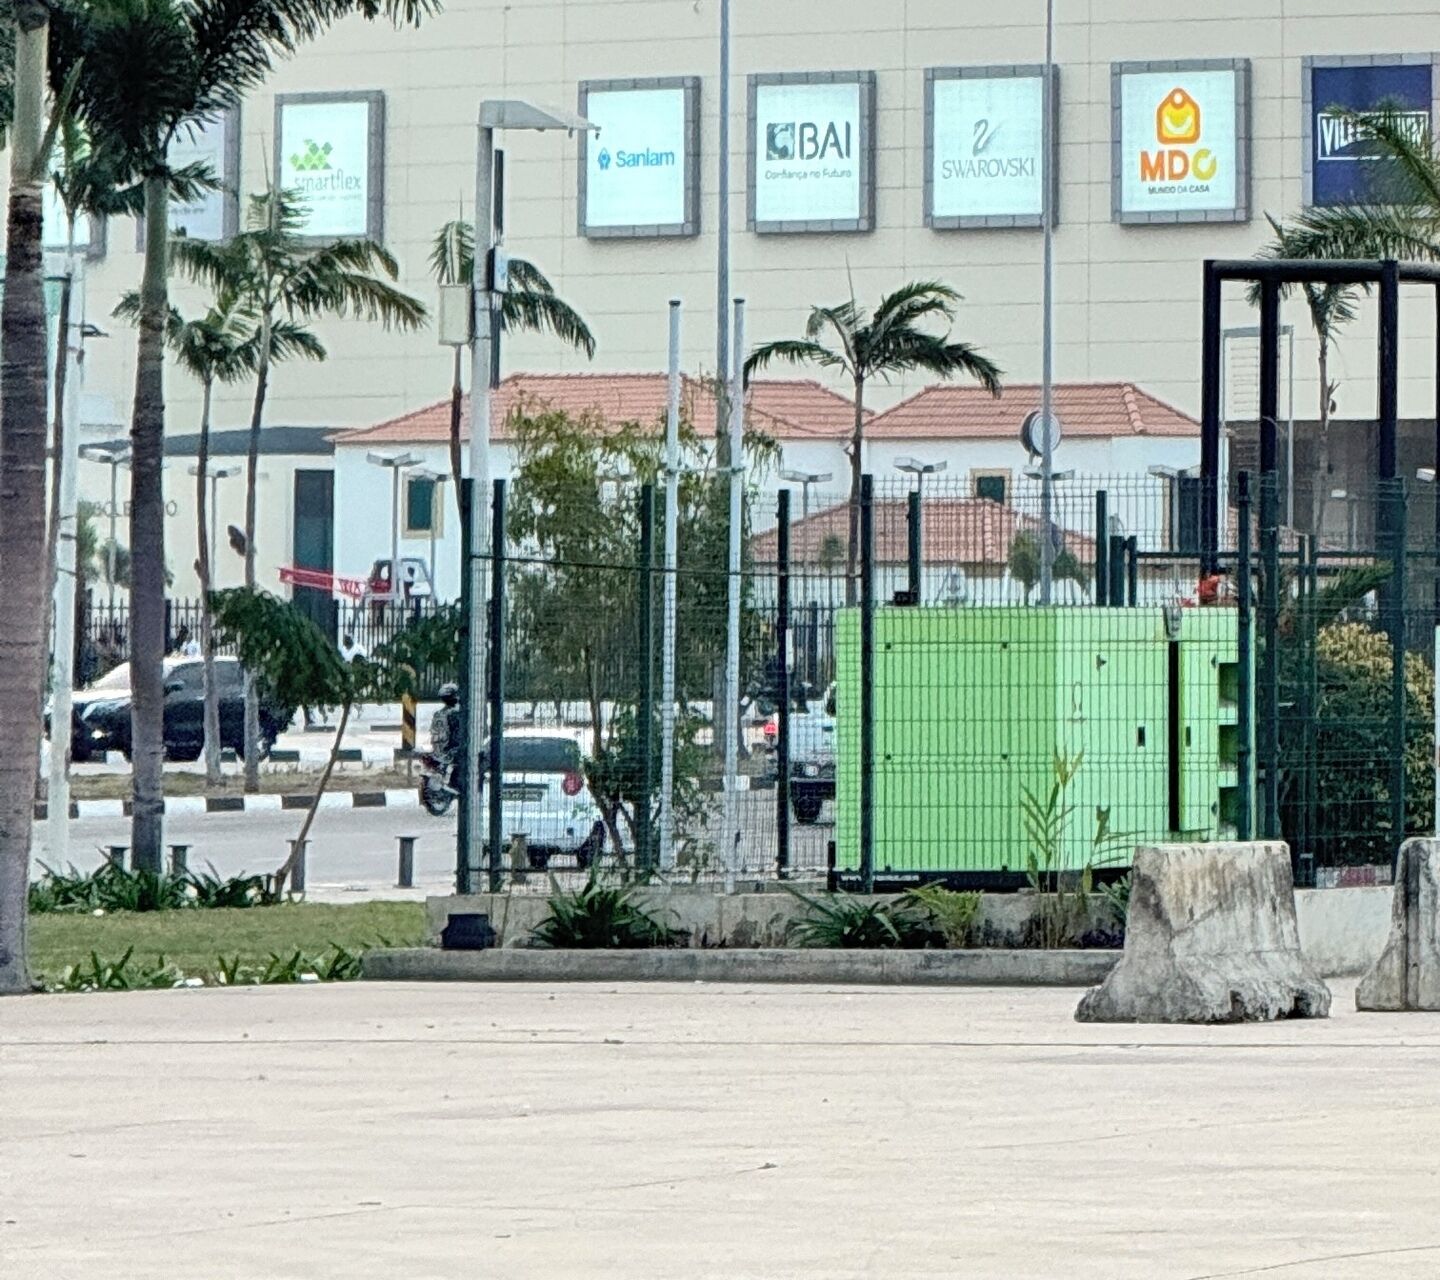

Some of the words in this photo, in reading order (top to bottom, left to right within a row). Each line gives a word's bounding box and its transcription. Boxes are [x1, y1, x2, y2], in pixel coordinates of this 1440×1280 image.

[799, 121, 851, 160] BAI
[615, 147, 675, 168] Sanlam
[942, 157, 1034, 179] SWAROVSKI
[294, 168, 362, 192] smartflex
[822, 168, 852, 179] Futuro
[1148, 185, 1176, 195] MUNDO
[1189, 183, 1211, 194] CASA
